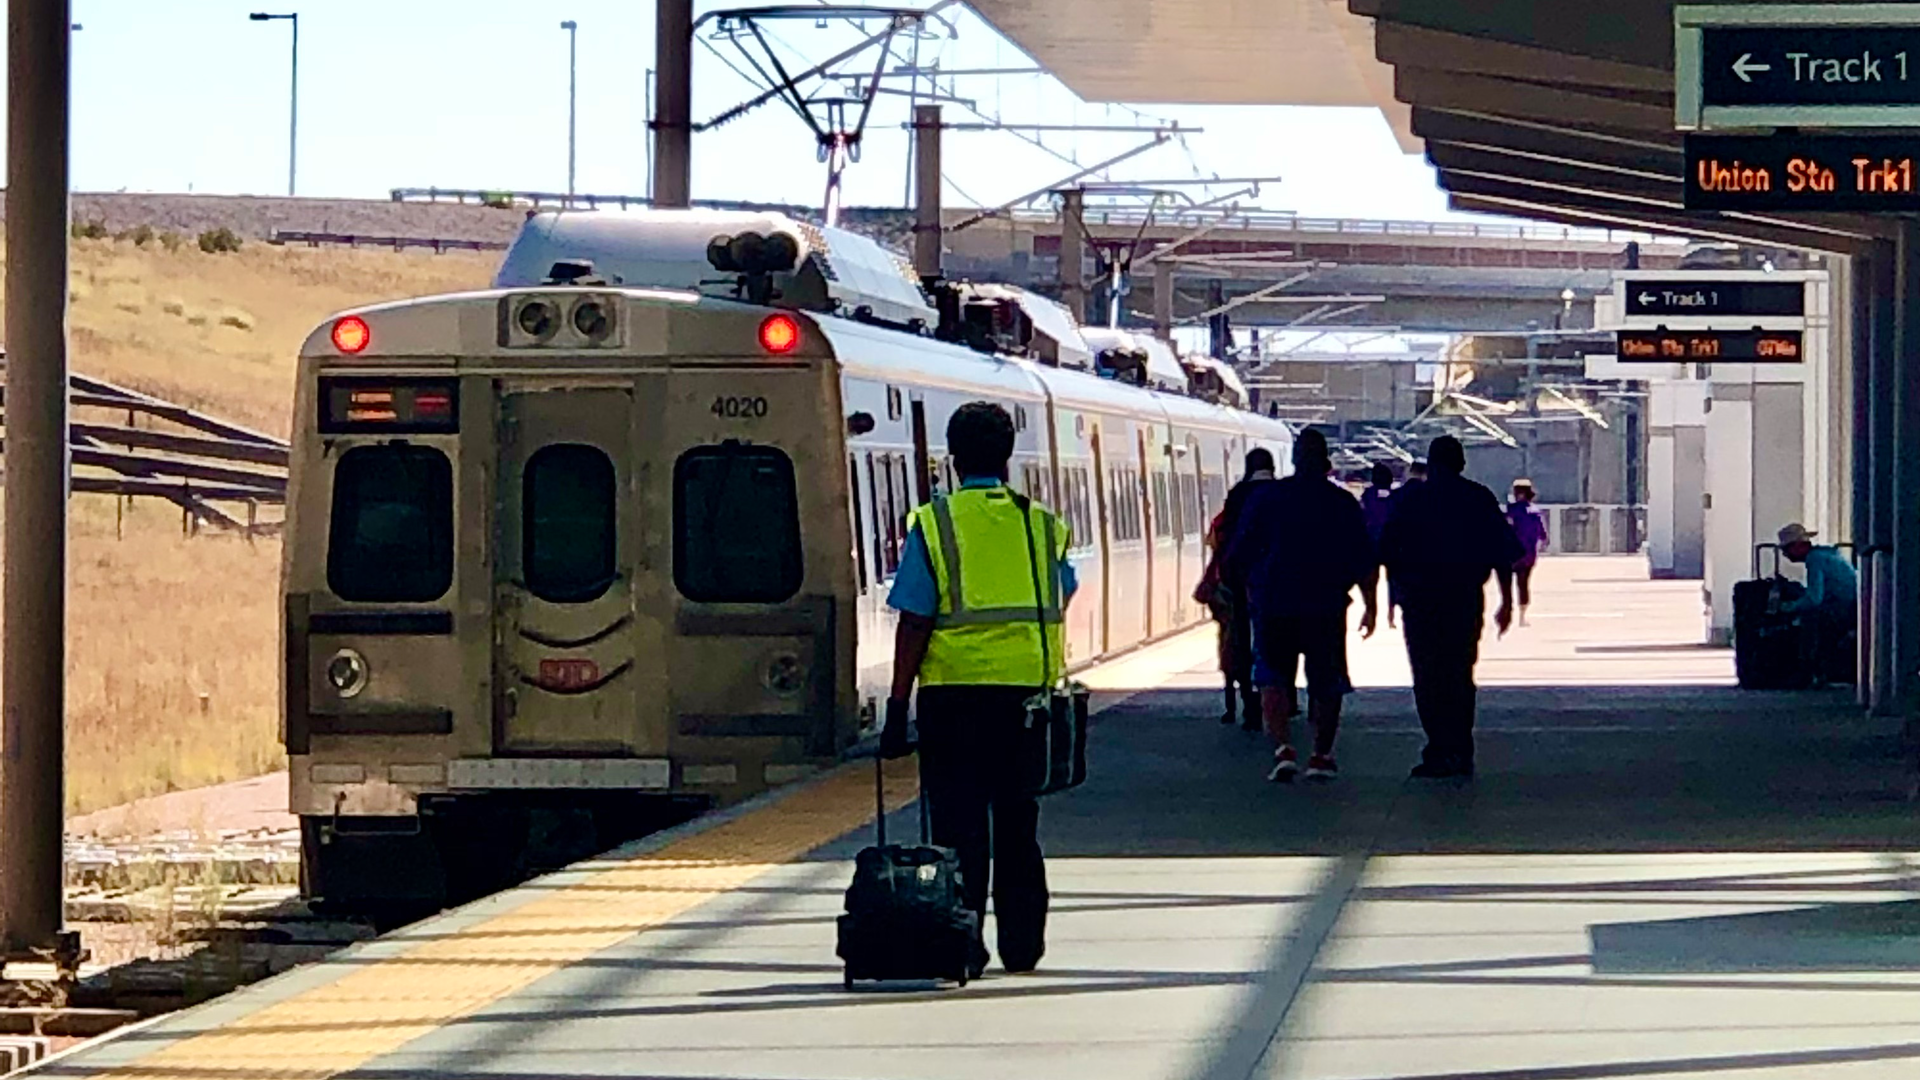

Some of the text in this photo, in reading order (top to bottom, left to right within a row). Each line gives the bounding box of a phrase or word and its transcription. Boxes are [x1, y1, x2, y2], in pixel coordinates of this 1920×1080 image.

[1786, 51, 1907, 82] Track 1
[1699, 158, 1910, 192] Union Stn Trk1
[1662, 291, 1719, 306] Track 1
[711, 397, 767, 417] 4020
